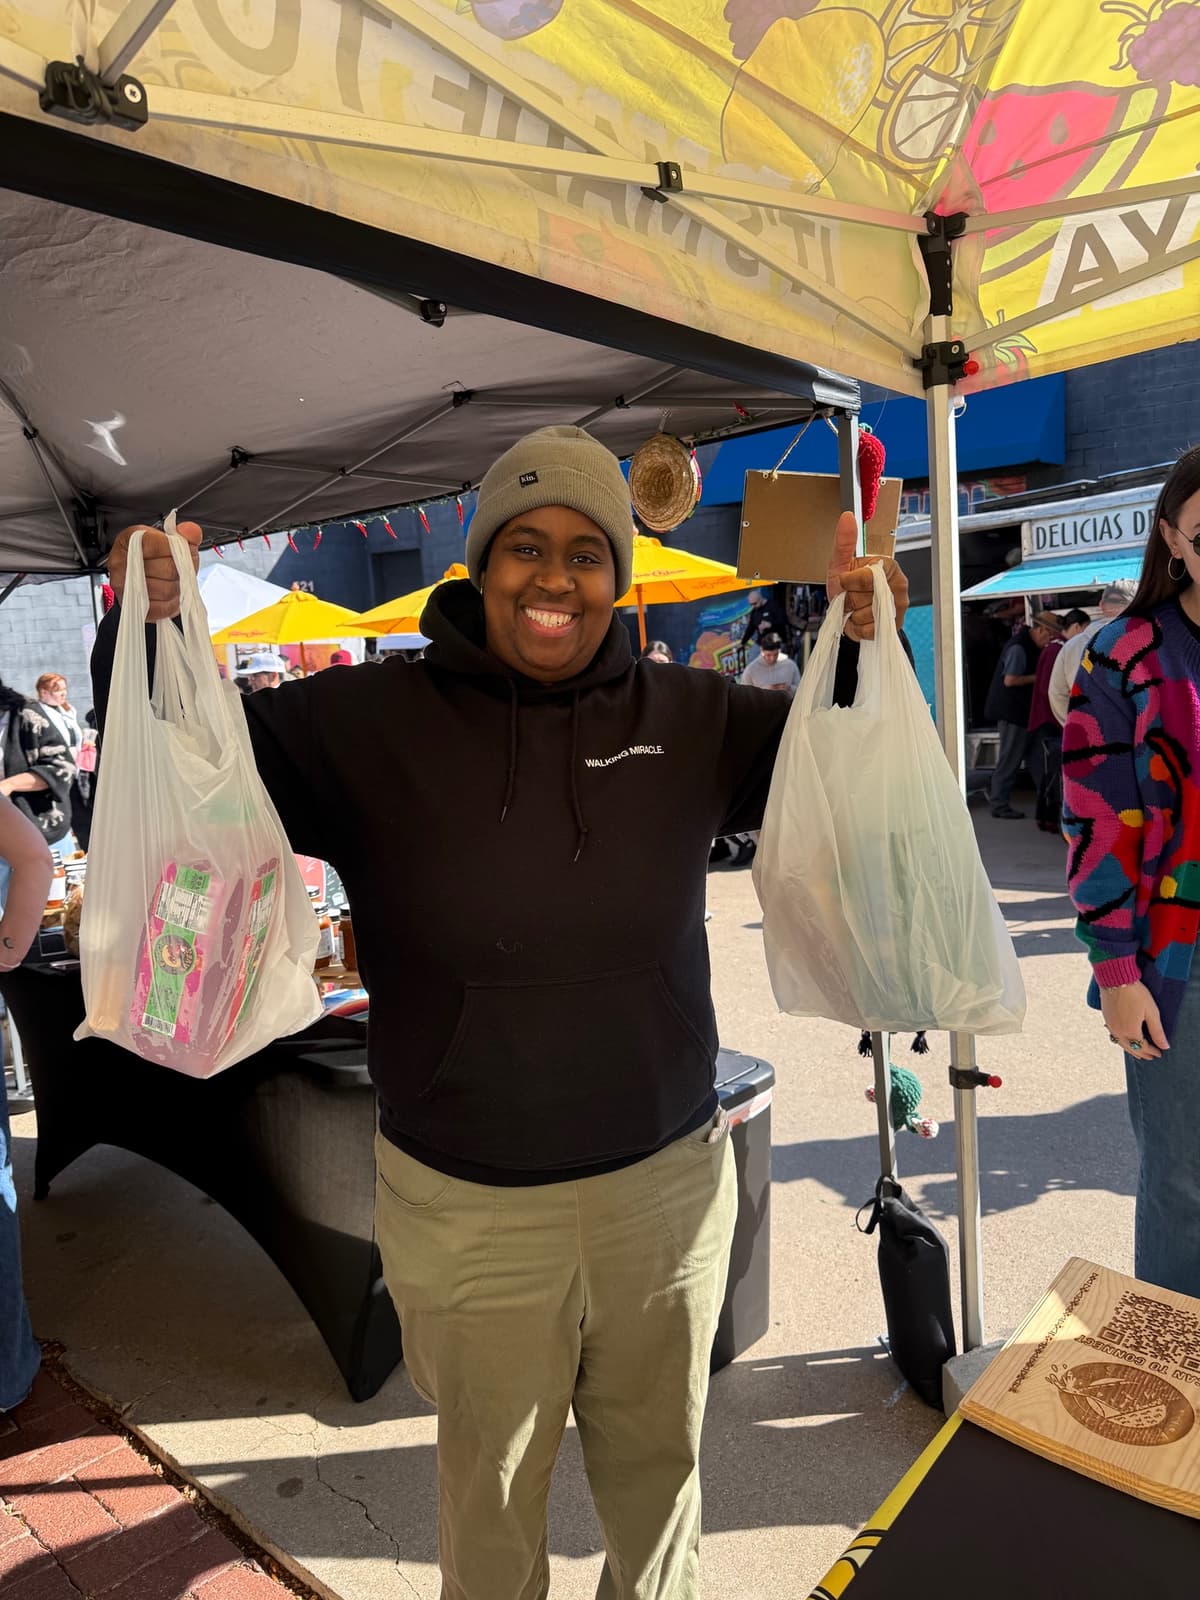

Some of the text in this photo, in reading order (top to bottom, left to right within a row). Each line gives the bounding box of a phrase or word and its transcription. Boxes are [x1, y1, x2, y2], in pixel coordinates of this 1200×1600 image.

[1036, 513, 1123, 550] DELICIAS
[585, 750, 629, 768] WALKING
[1074, 1334, 1146, 1366] CONNECT
[1149, 1361, 1169, 1375] TO
